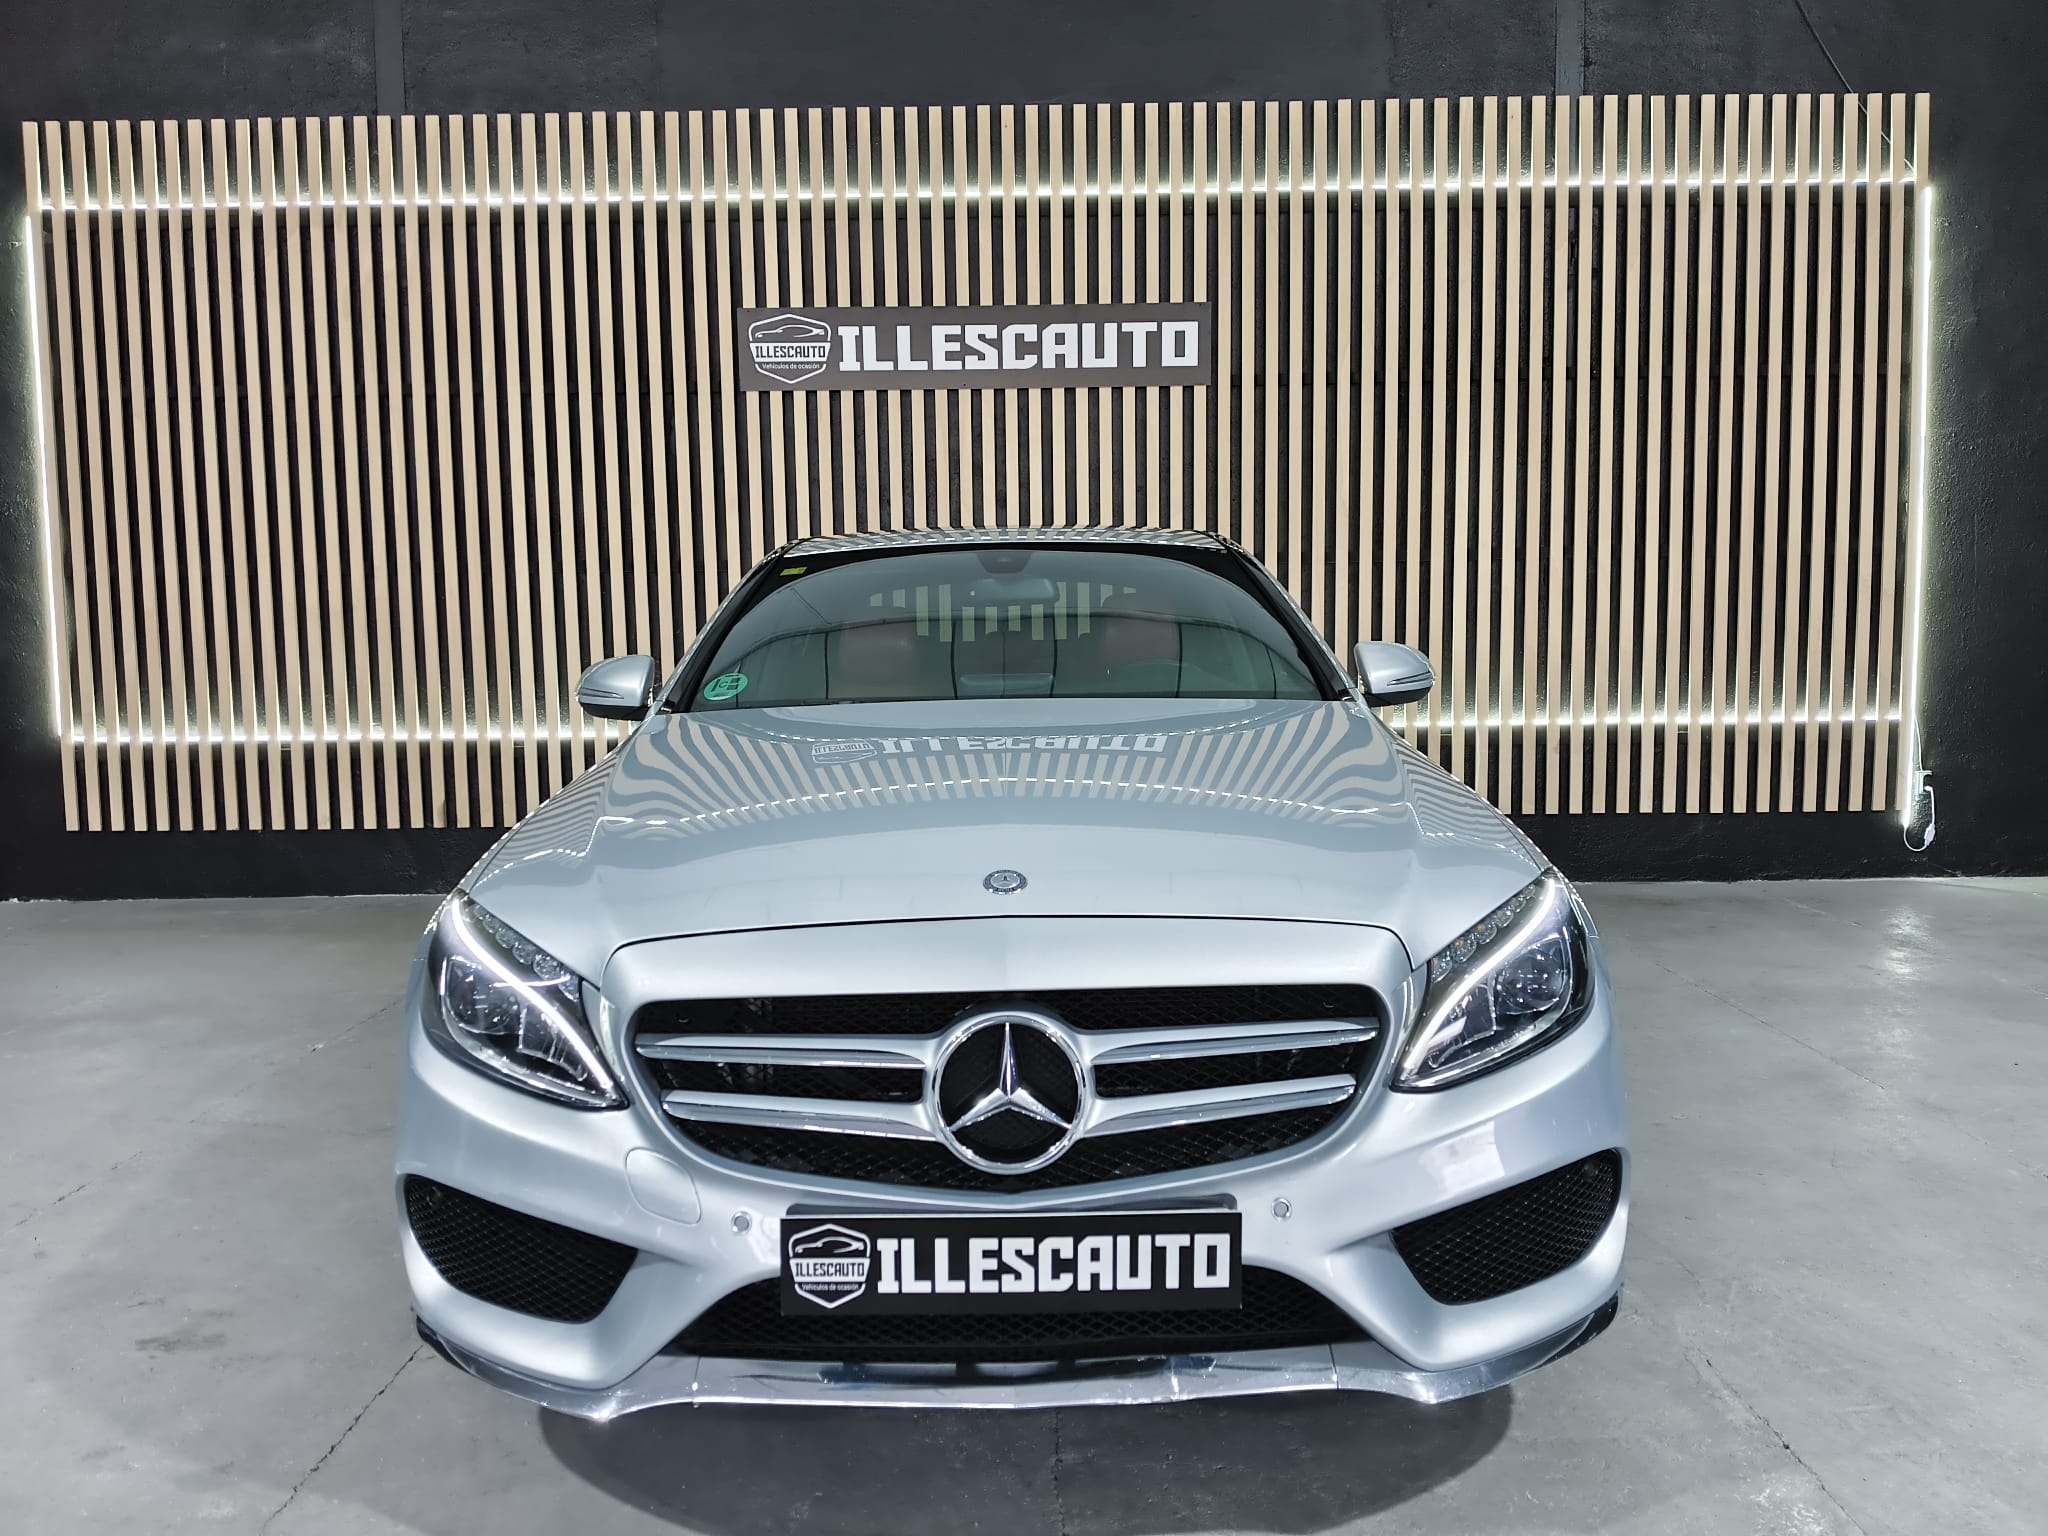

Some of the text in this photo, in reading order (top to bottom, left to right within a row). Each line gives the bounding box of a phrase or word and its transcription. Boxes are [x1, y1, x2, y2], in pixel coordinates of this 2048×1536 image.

[755, 345, 826, 358] ILLESCAUTO
[838, 321, 1199, 371] ILLESCAUTO
[789, 362, 797, 370] de
[795, 1262, 865, 1277] ILLESCAUTO
[877, 1233, 1231, 1294] ILLESCAUTO
